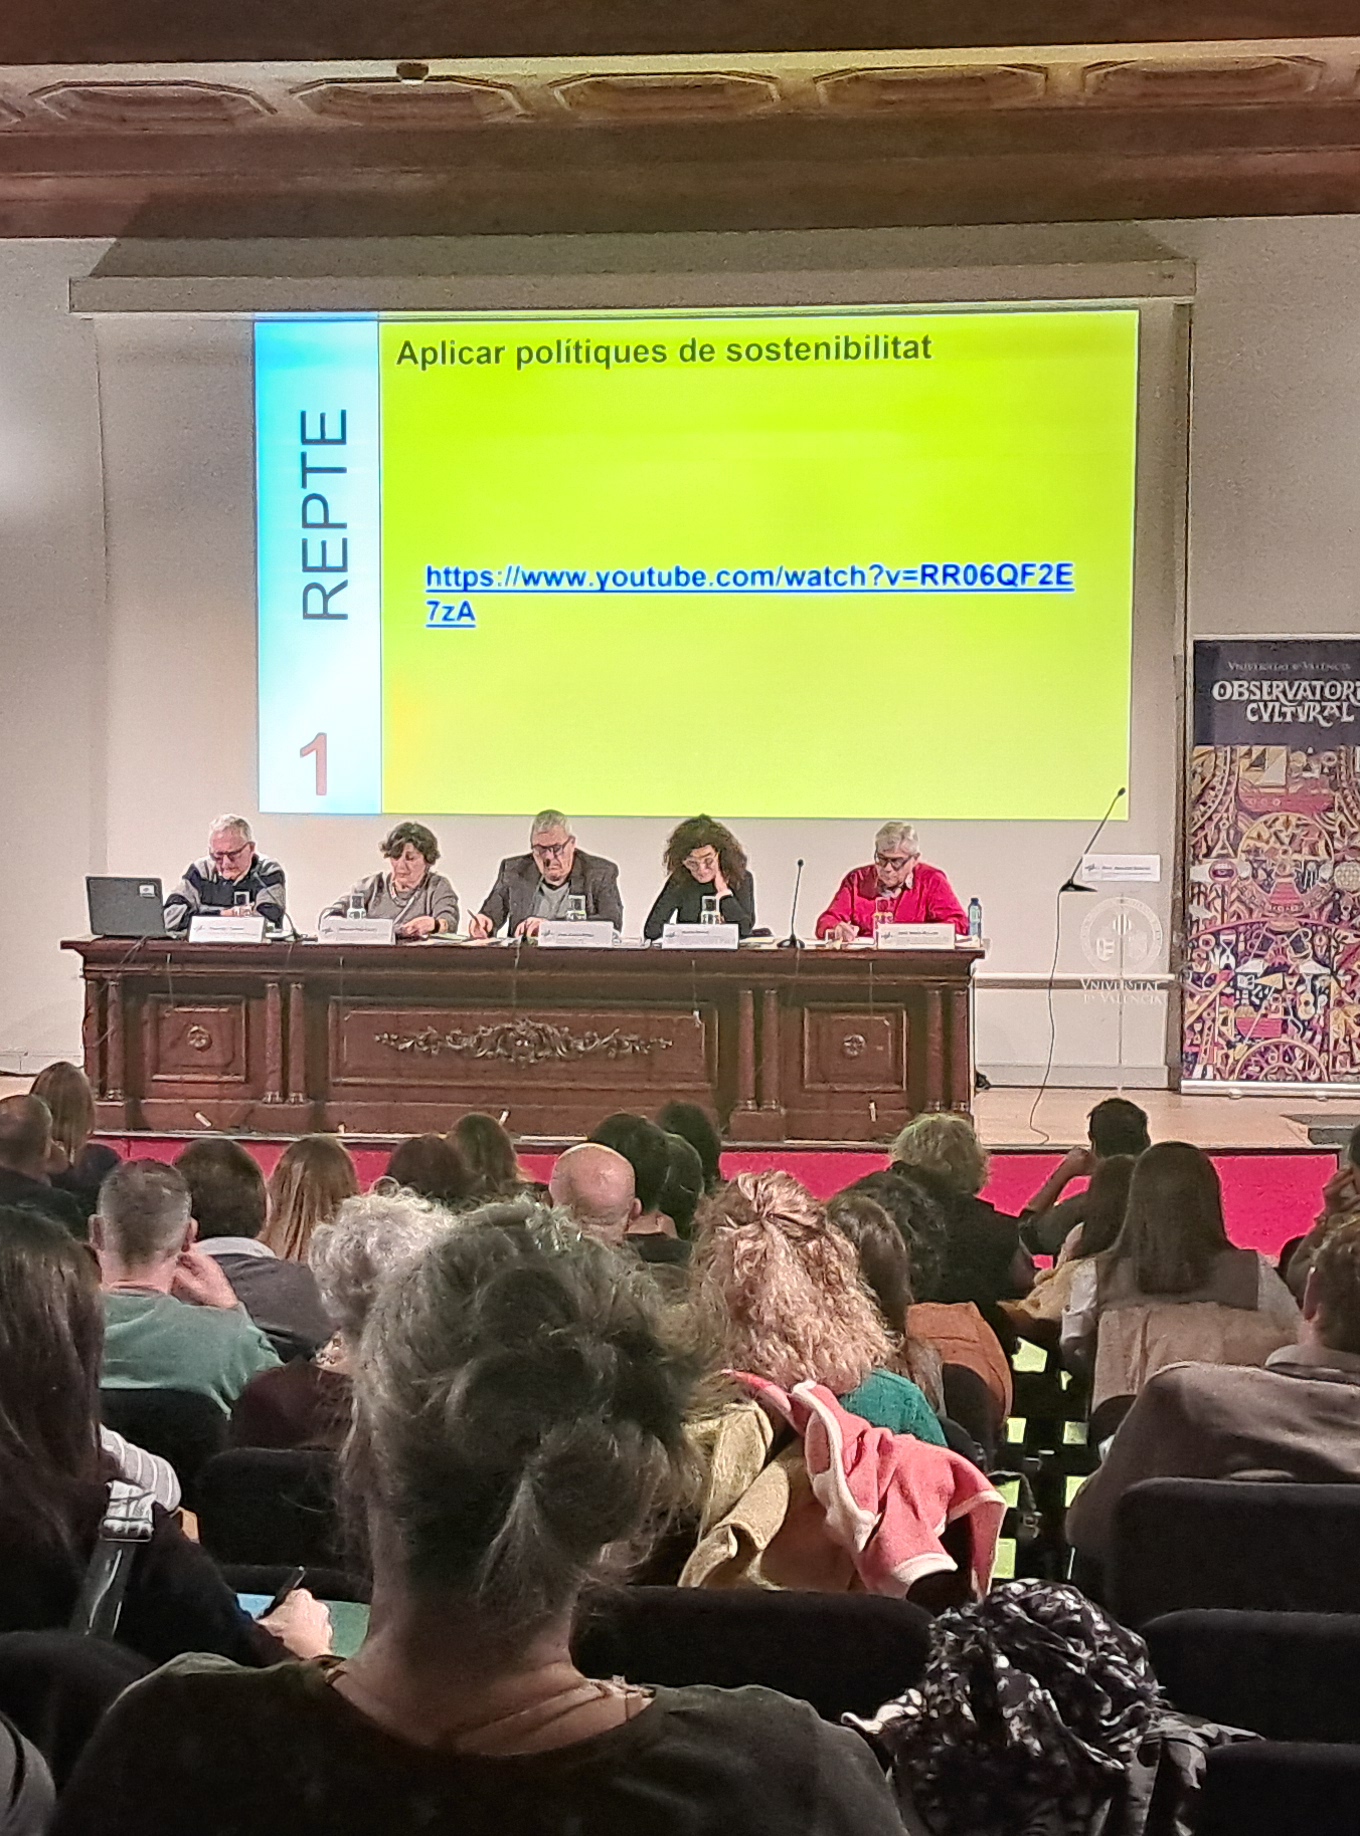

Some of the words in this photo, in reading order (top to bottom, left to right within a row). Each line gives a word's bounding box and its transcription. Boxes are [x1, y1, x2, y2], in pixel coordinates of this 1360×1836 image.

[396, 340, 506, 371] Aplicar
[516, 338, 668, 371] polítiques
[679, 337, 716, 363] de
[726, 334, 933, 363] sostenibilitat
[300, 409, 349, 621] REPTE
[425, 600, 477, 623] 7zA
[299, 731, 328, 797] 1
